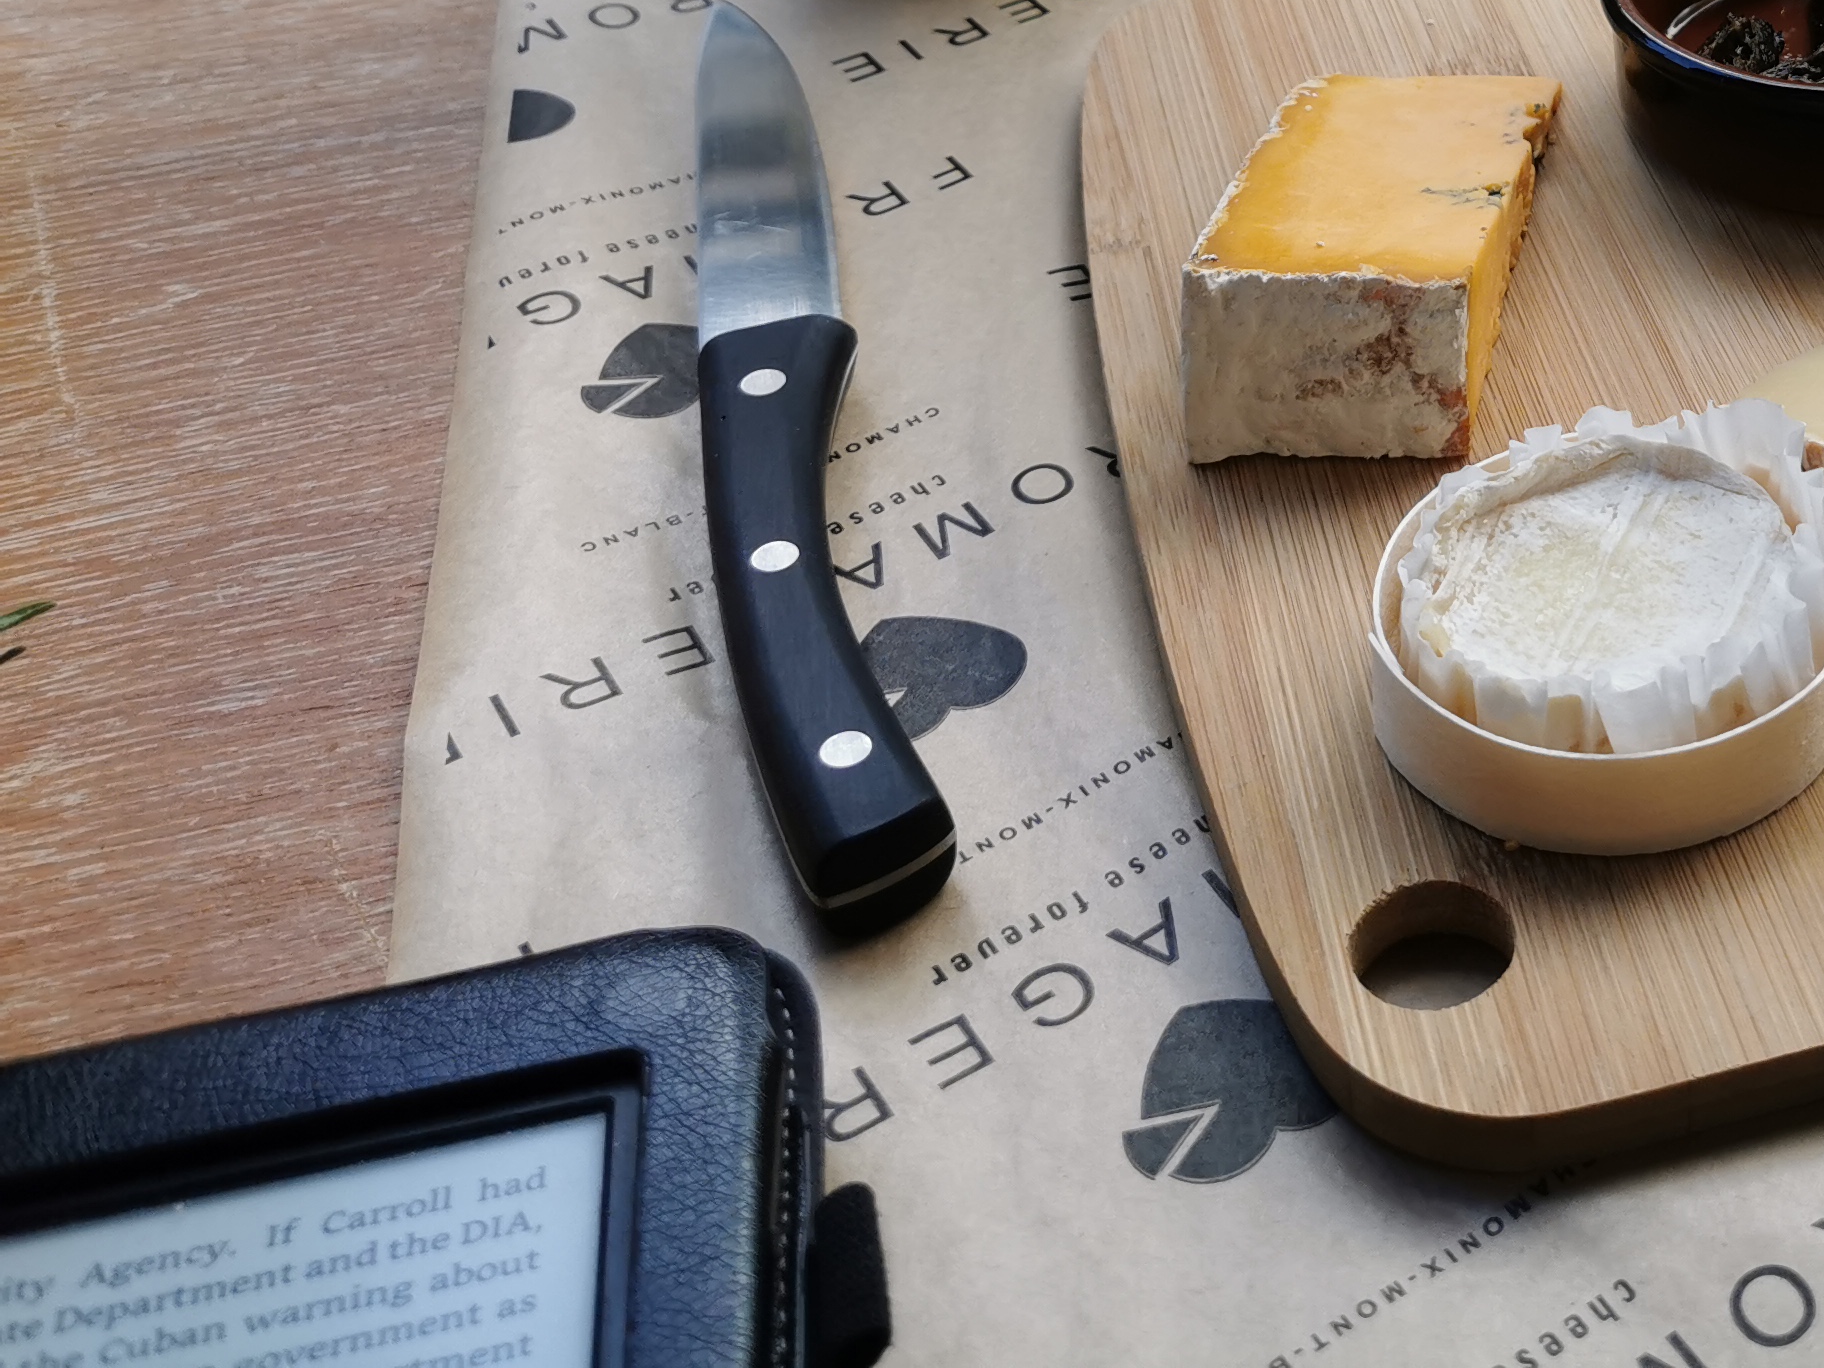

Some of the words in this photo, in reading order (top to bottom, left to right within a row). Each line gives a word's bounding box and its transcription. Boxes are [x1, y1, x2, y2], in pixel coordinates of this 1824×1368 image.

[322, 1185, 454, 1235] Carroll
[477, 1164, 548, 1203] had
[53, 1263, 296, 1335] Department
[303, 1239, 379, 1280] and
[388, 1232, 451, 1261] the
[461, 1210, 543, 1246] DIA,
[99, 1321, 228, 1365] Cuban
[243, 1282, 414, 1333] warning
[429, 1248, 542, 1293] about
[496, 1292, 539, 1321] as
